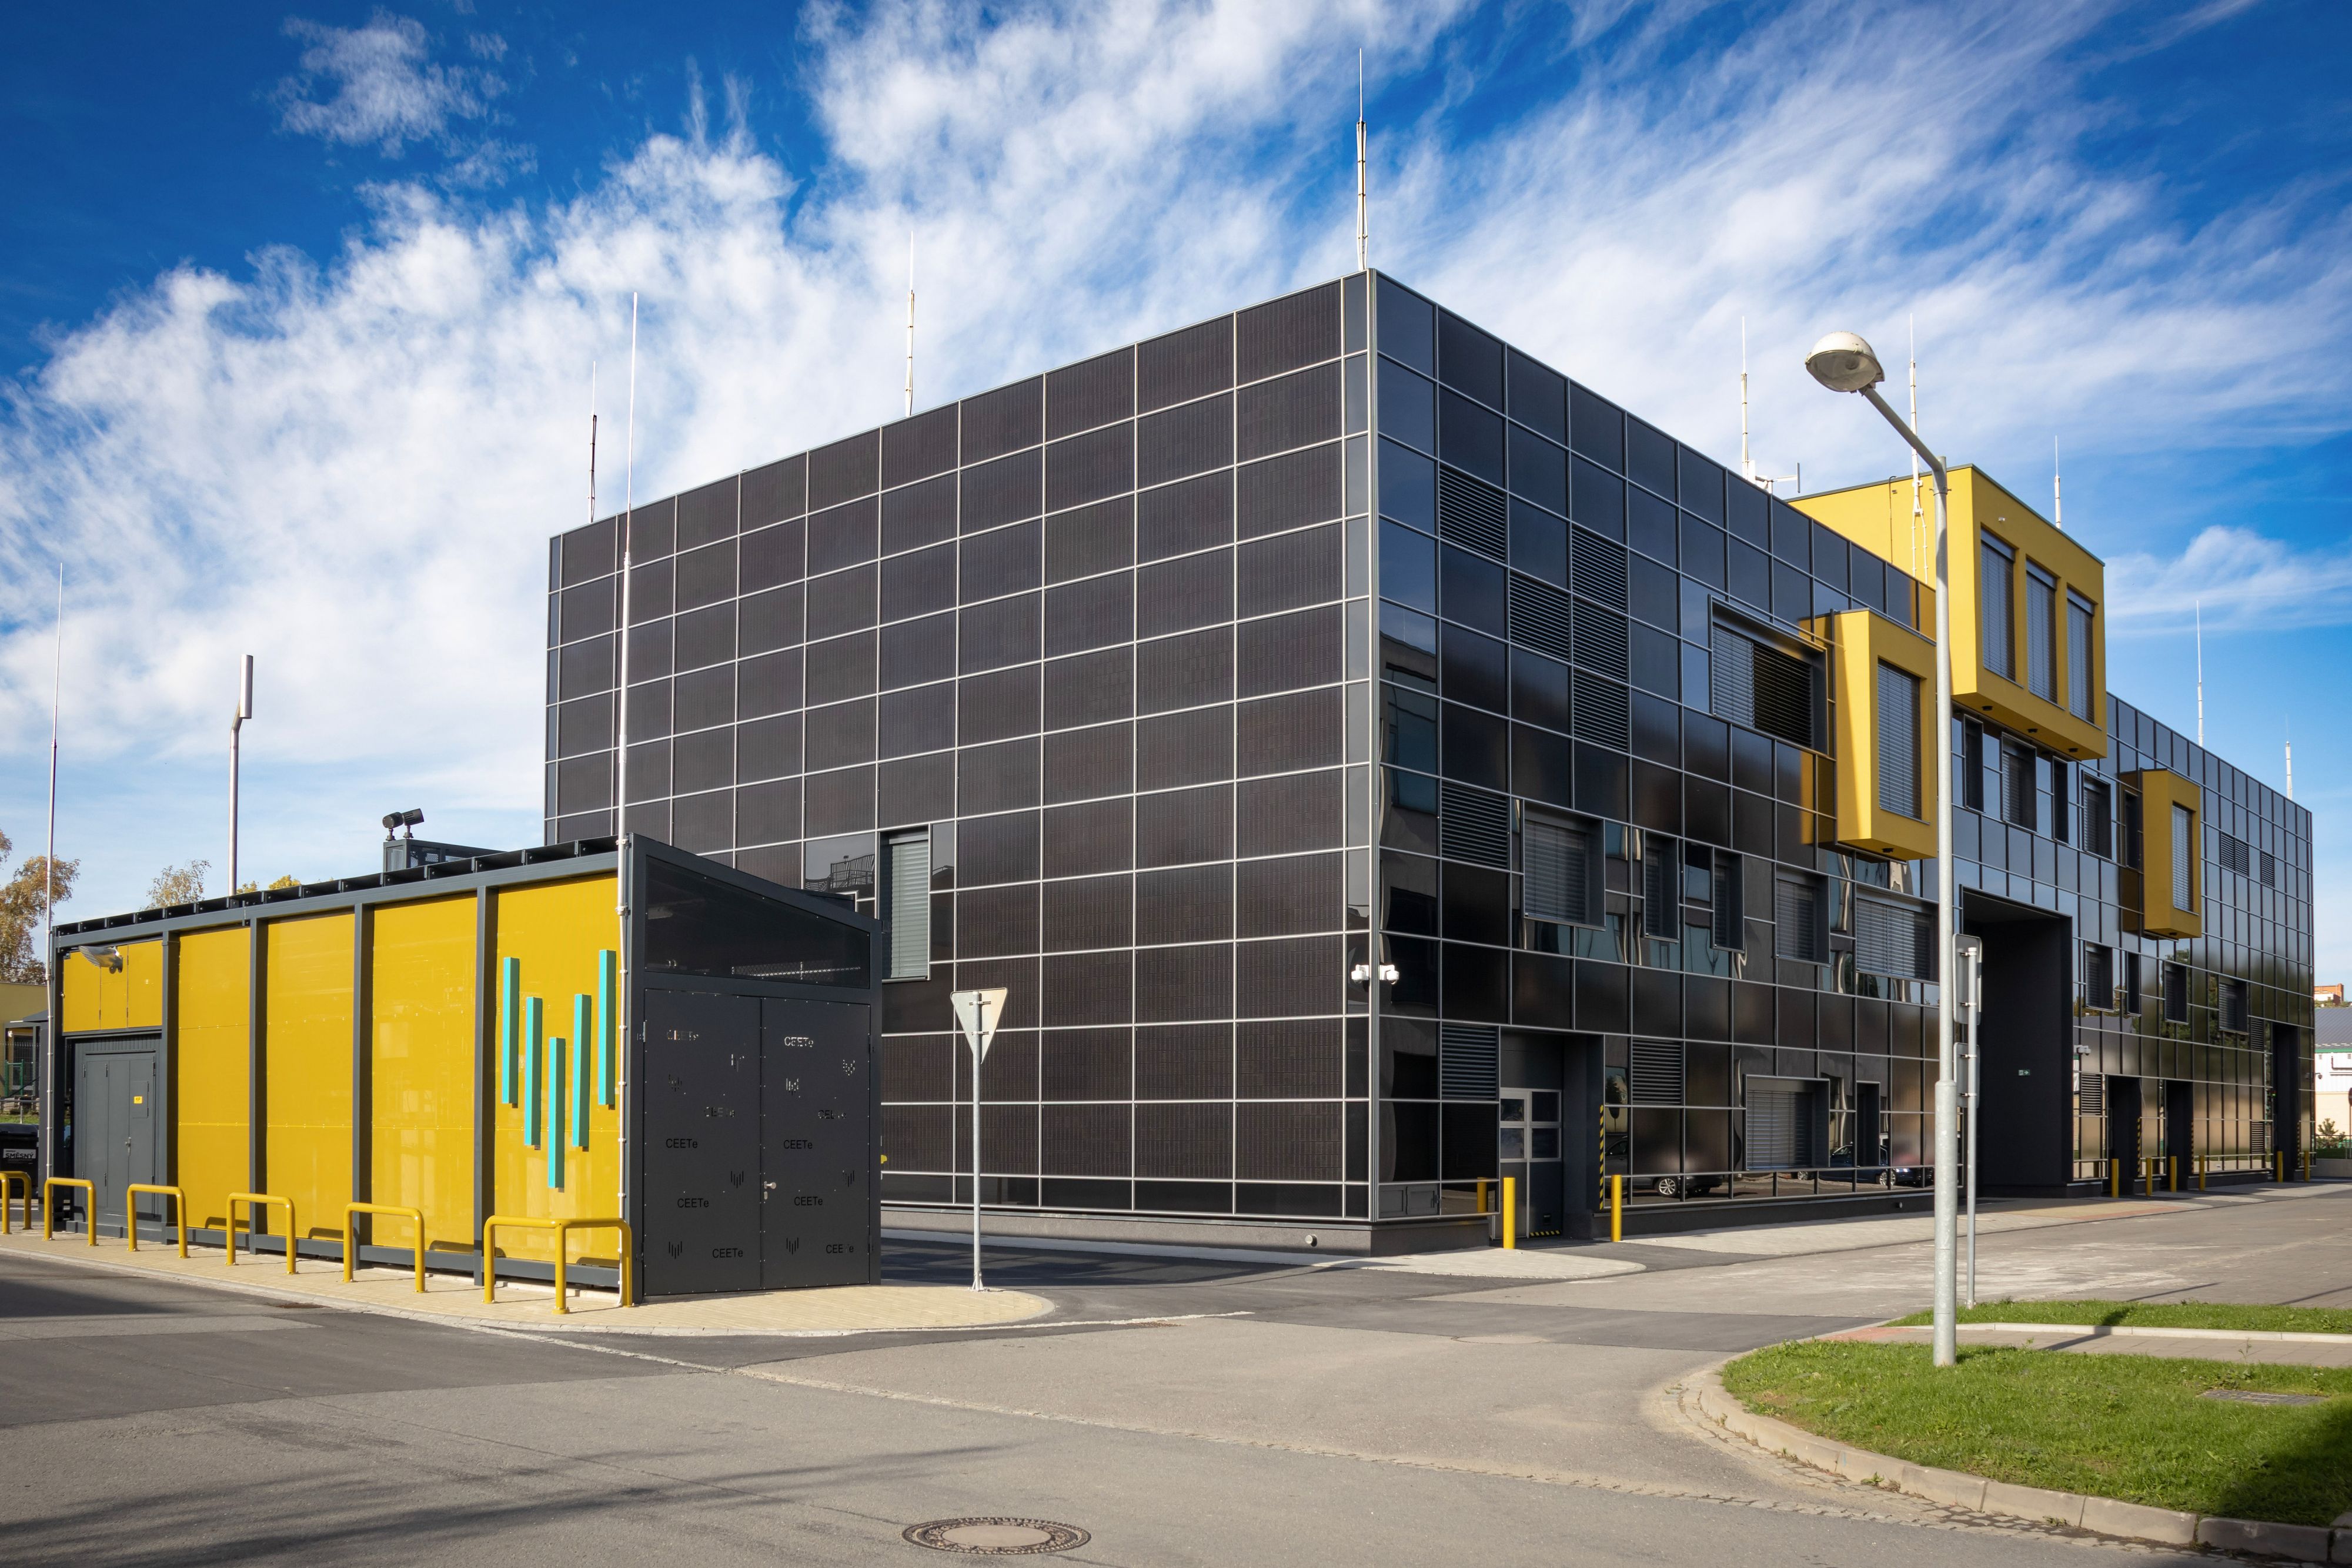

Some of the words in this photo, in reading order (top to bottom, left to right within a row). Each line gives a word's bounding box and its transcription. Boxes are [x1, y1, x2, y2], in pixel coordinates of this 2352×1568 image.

[666, 1138, 698, 1148] CEETe
[783, 1139, 813, 1149] CEETe
[677, 1198, 709, 1208] CEETe
[794, 1196, 823, 1206] CEETe
[712, 1248, 744, 1258] CEETe
[826, 1244, 854, 1254] CEEe
